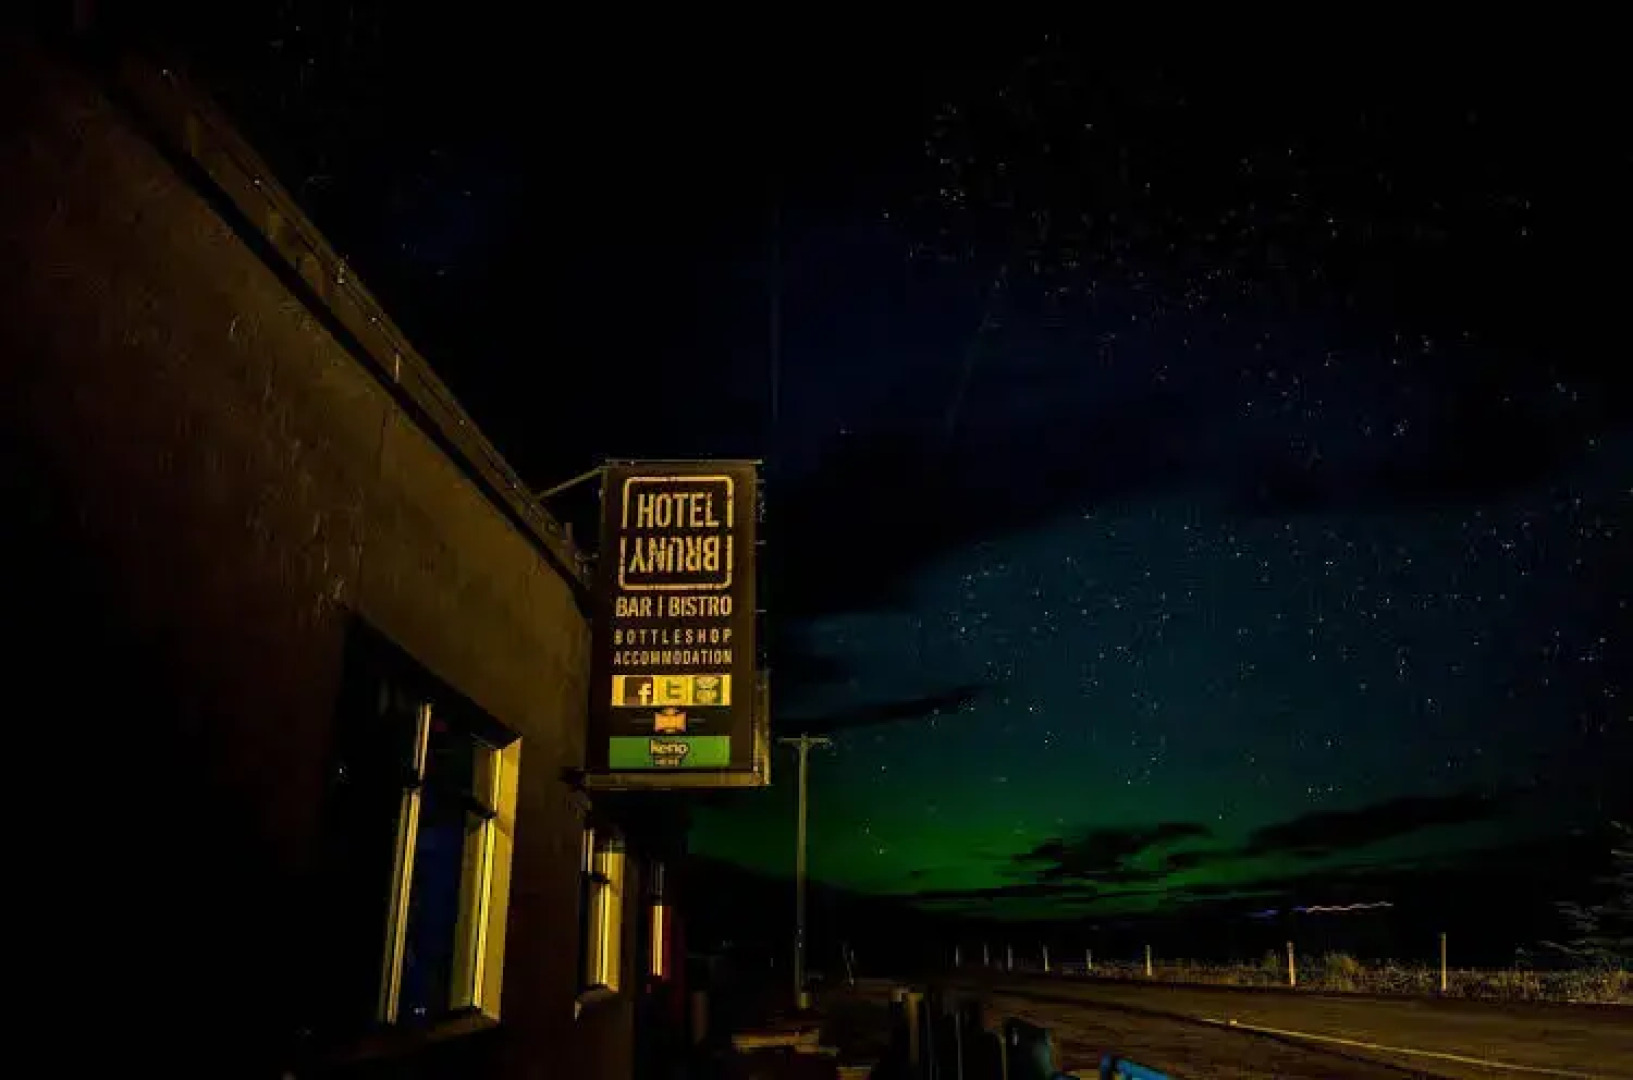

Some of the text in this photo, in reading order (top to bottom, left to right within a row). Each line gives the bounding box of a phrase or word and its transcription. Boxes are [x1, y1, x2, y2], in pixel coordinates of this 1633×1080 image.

[637, 493, 720, 528] HOTEL
[629, 536, 720, 573] BRUNY
[616, 596, 651, 617] BAR
[668, 595, 732, 617] BISTRO
[614, 629, 732, 645] BOTTLESHOP
[614, 650, 732, 665] ACCOMMODATION
